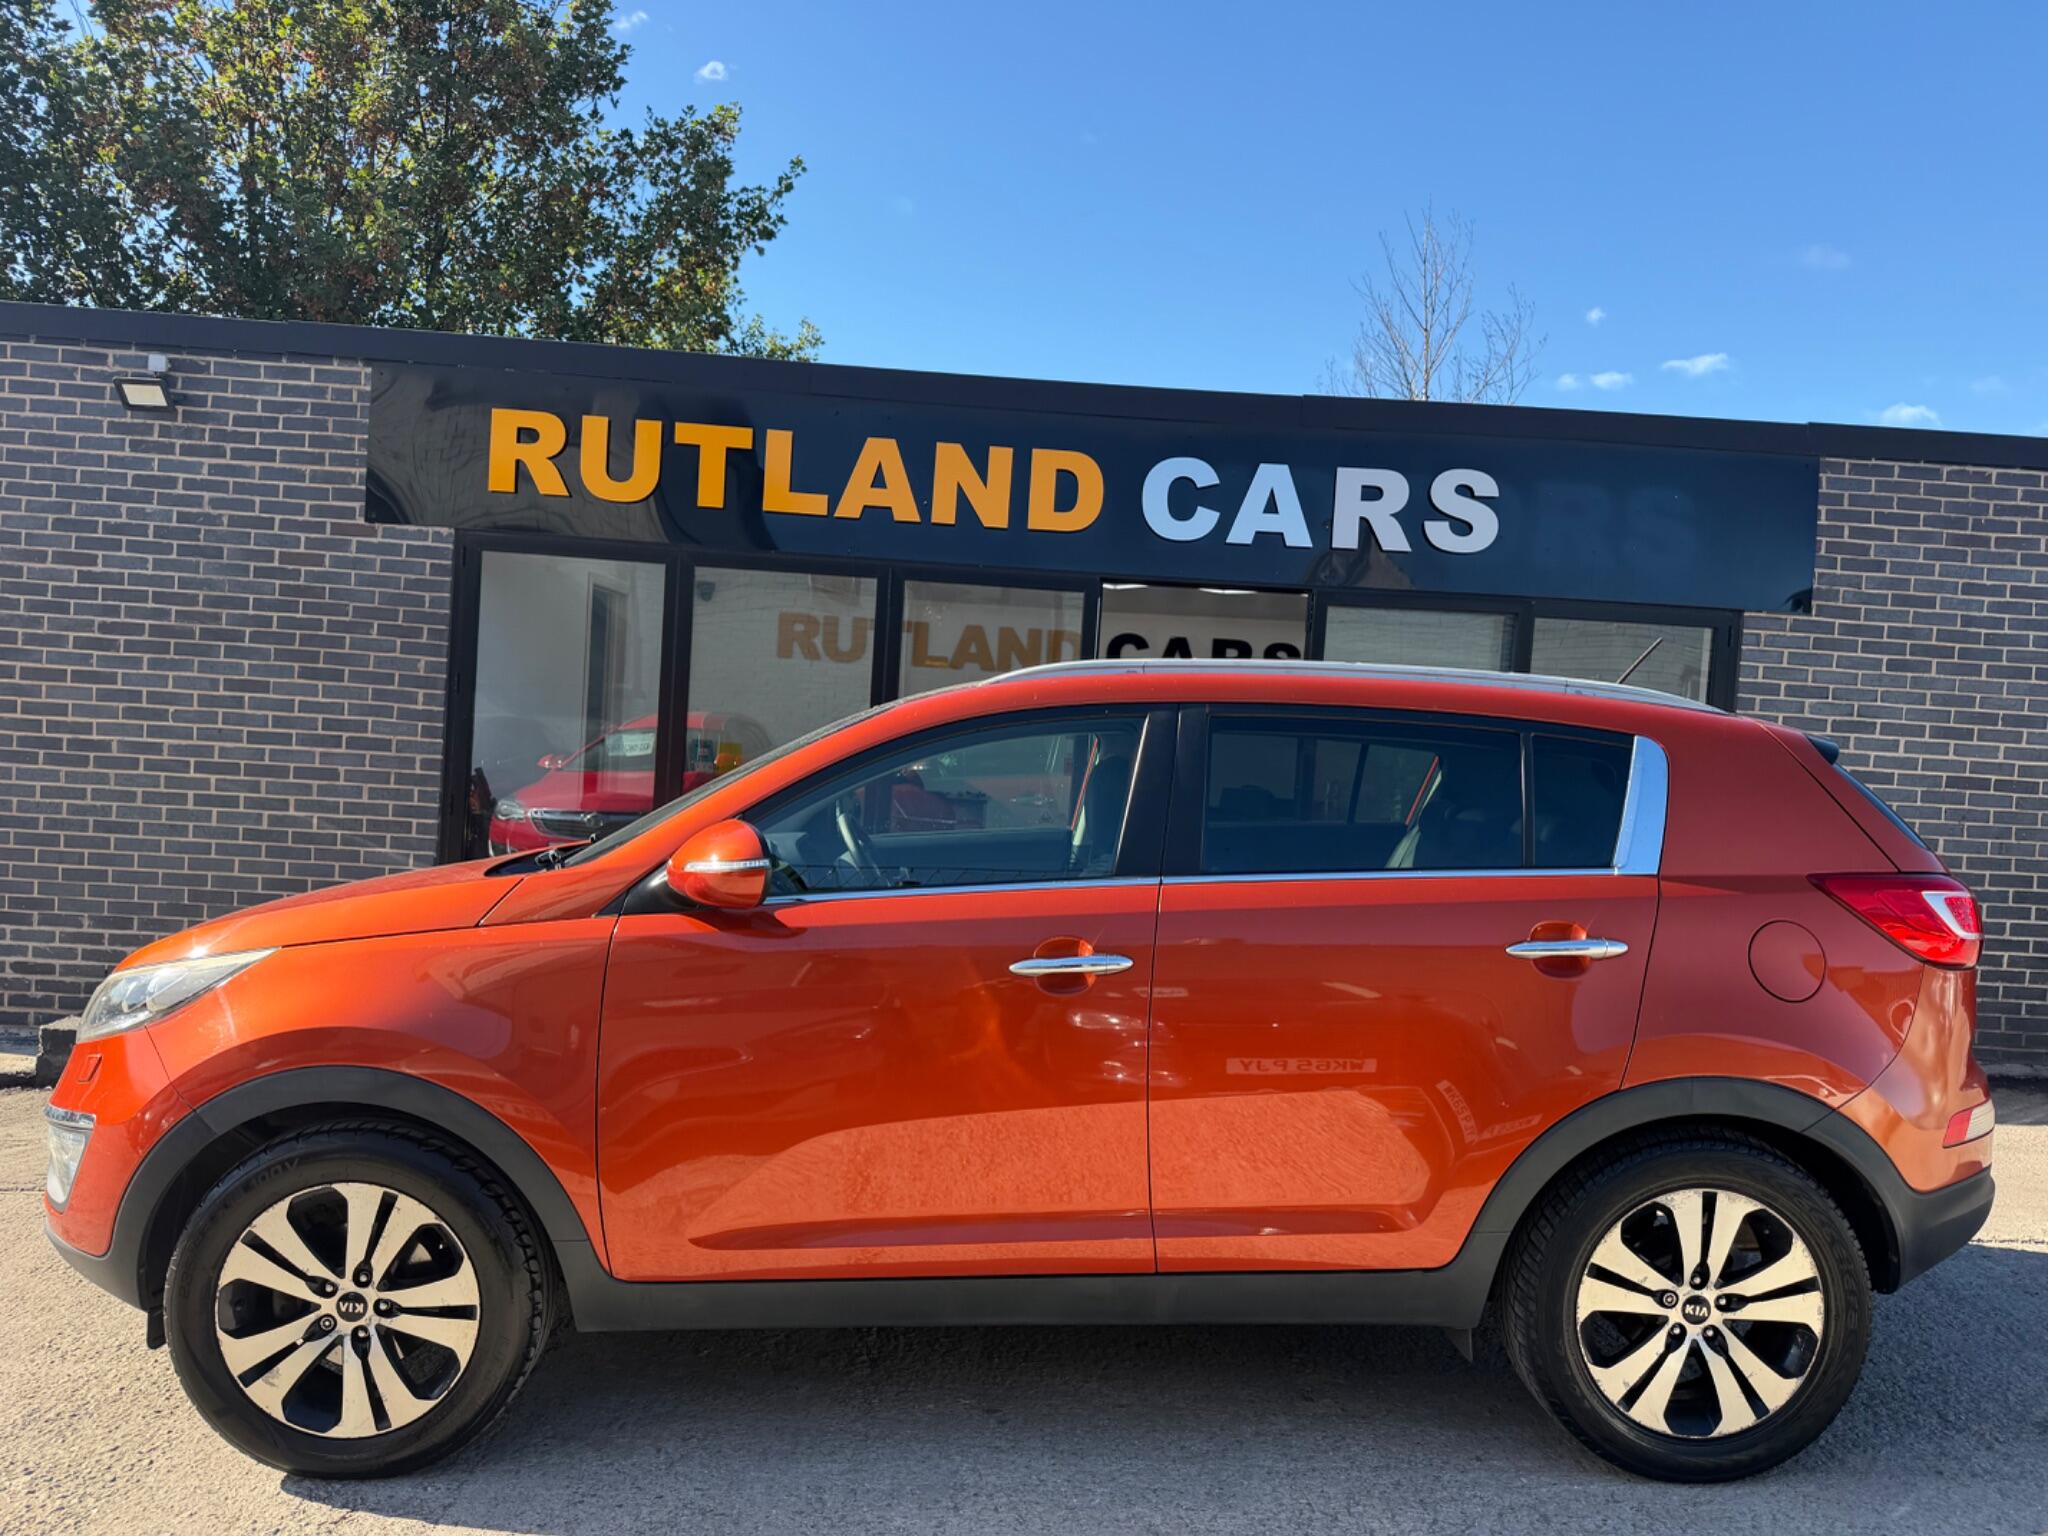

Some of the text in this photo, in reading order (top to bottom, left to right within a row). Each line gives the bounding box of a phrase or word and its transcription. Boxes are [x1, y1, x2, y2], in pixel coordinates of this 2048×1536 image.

[488, 407, 1104, 532] RUTLAND
[1142, 457, 1500, 554] CARS
[777, 611, 1082, 671] RULAND
[339, 1301, 364, 1313] KIA
[1685, 1304, 1708, 1317] KIA
